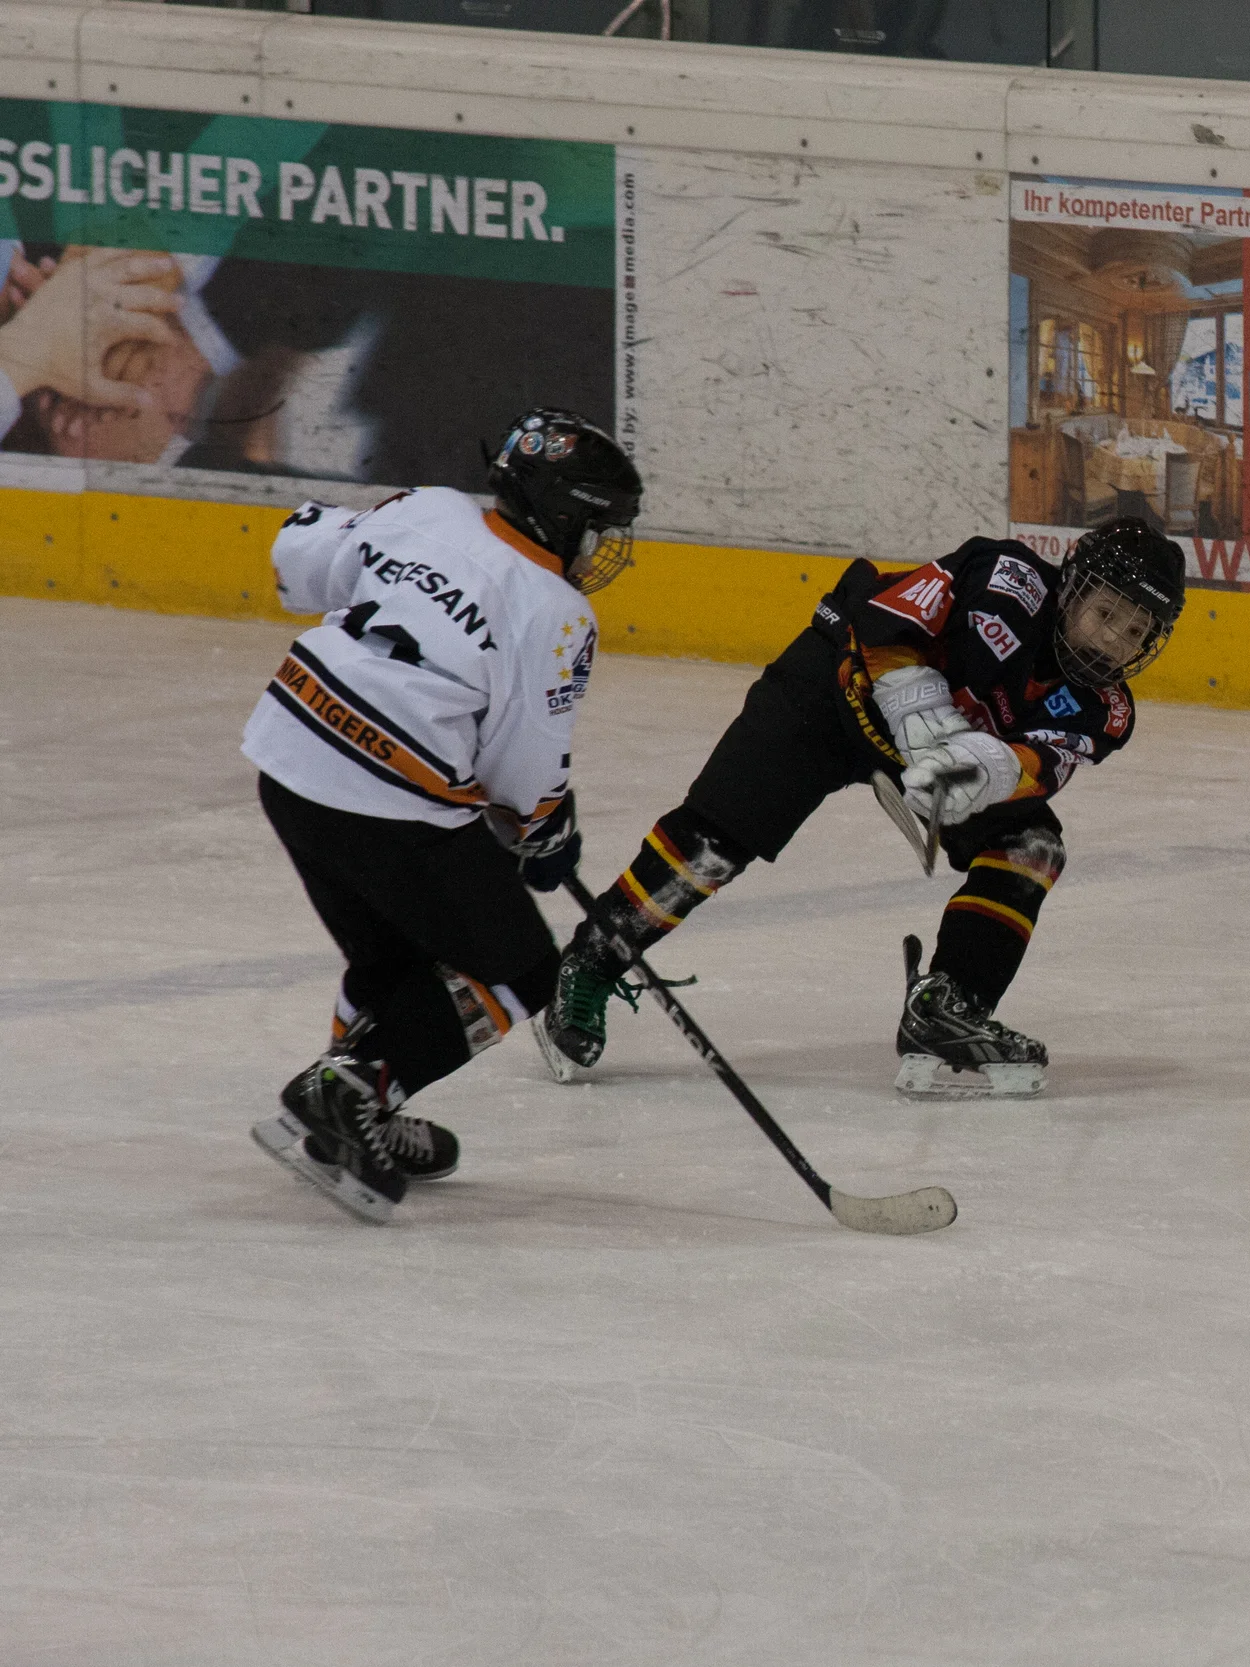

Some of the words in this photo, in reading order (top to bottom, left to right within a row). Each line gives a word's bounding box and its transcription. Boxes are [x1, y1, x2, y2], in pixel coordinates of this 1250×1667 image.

[278, 162, 566, 242] PARTNER.
[1024, 188, 1053, 213] Ihr
[1059, 193, 1194, 224] kompetenter
[1139, 580, 1171, 605] BAUER
[306, 684, 399, 761] TIGERS
